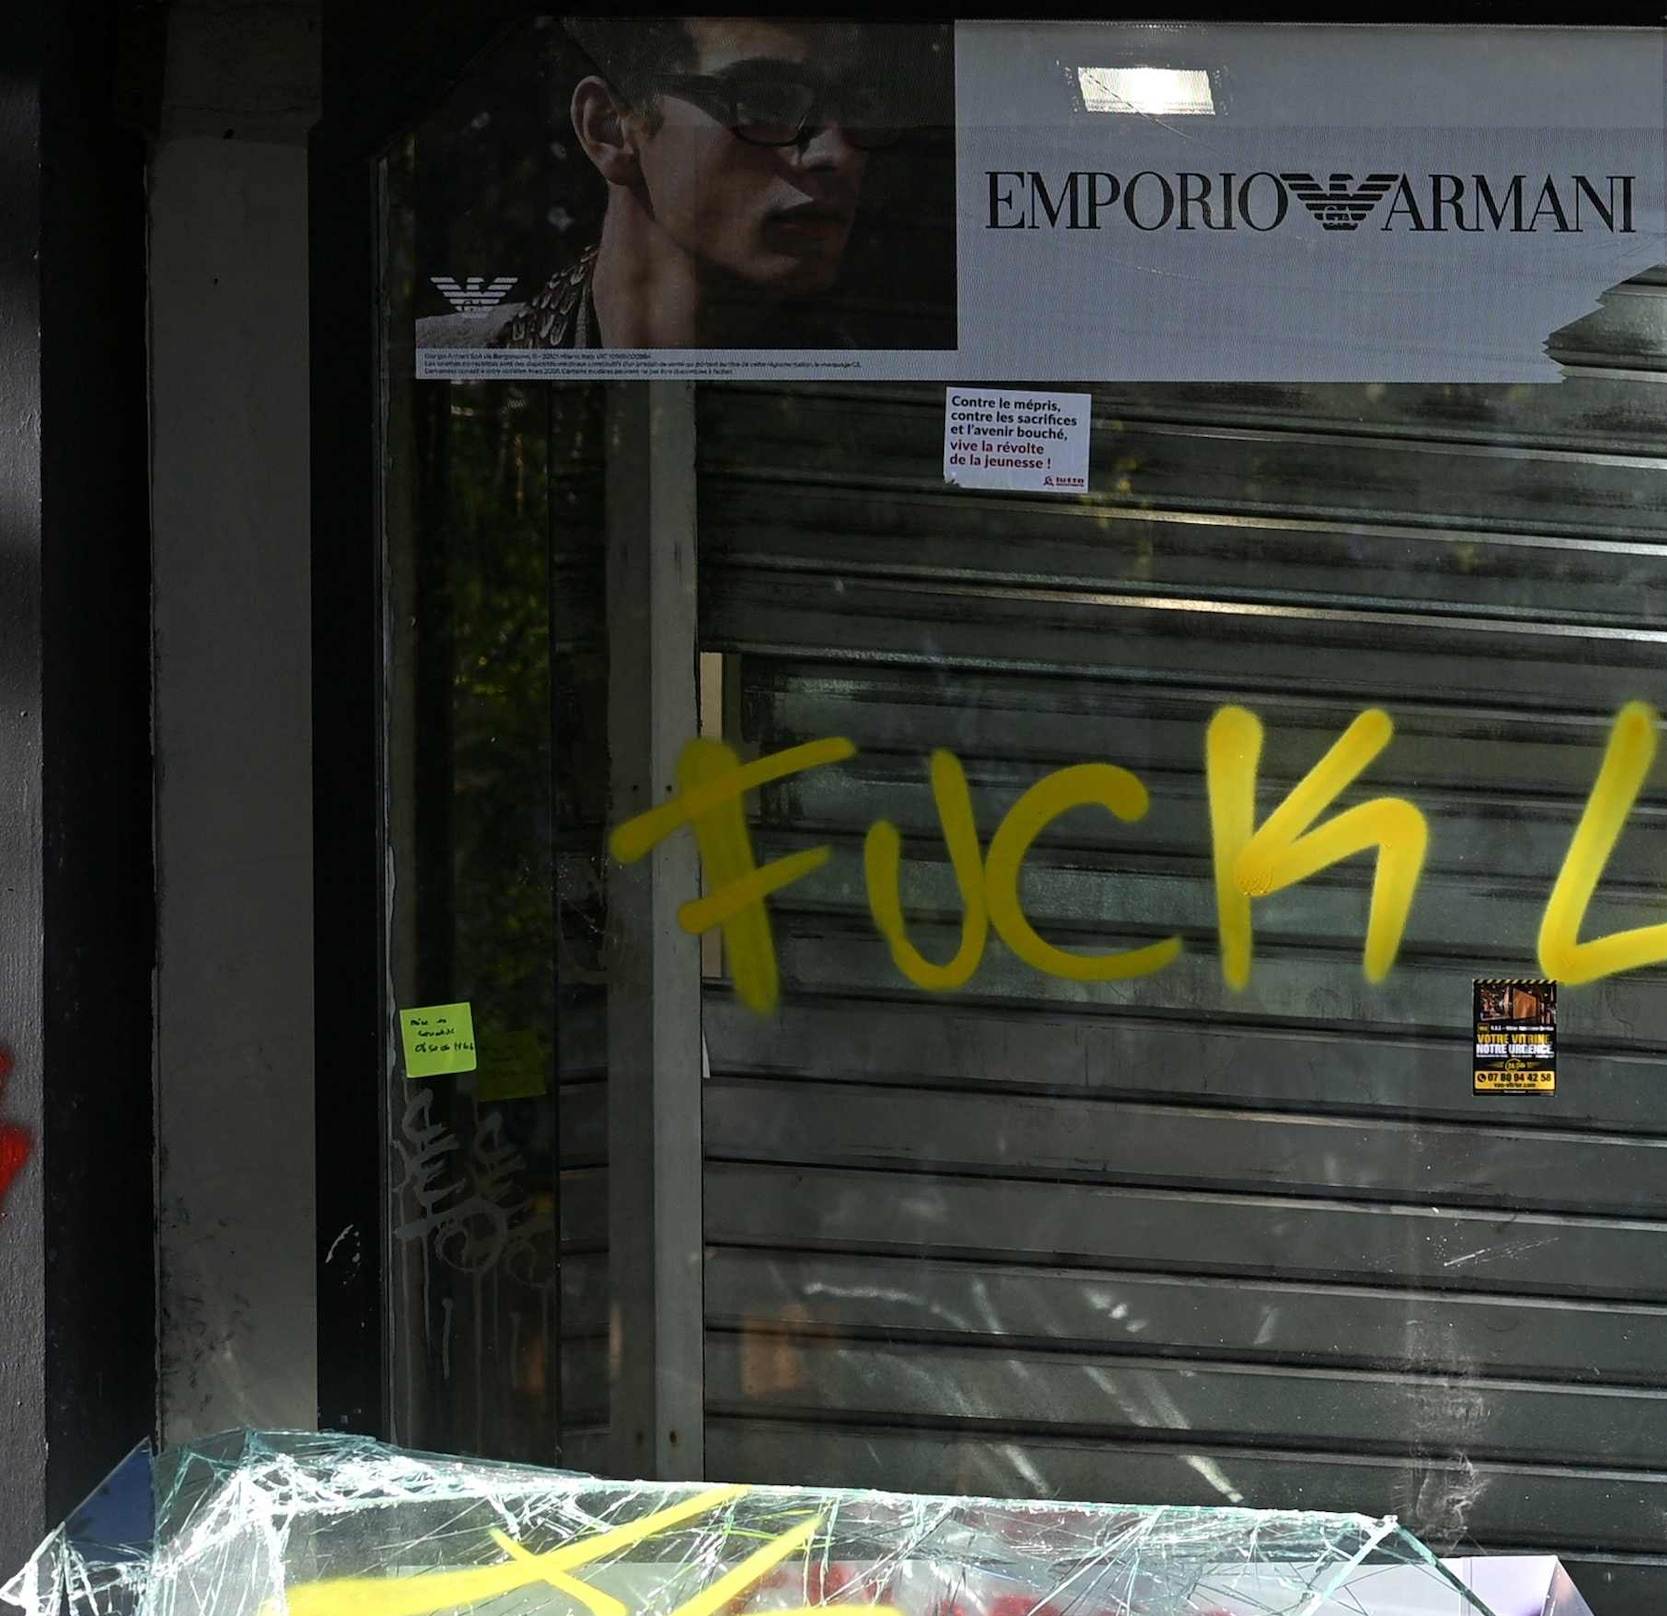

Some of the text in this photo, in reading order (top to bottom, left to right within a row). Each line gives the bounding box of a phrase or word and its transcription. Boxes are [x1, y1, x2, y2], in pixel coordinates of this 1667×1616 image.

[986, 171, 1636, 234] EMPORIO ARMANI
[952, 395, 1061, 413] Contre le mépris,
[951, 410, 1077, 426] contre les sacrifices
[950, 424, 1068, 441] et l'avenir bouché,
[950, 439, 1044, 454] vive la révolte
[950, 453, 966, 465] de
[970, 454, 981, 466] la
[984, 455, 1043, 469] jeunesse
[607, 703, 1429, 1018] FUCK
[1477, 1034, 1509, 1044] VOTRE
[1476, 1044, 1507, 1053] NOTRE
[1488, 1073, 1498, 1081] 07
[1527, 1073, 1539, 1081] 42
[1540, 1073, 1552, 1081] 58
